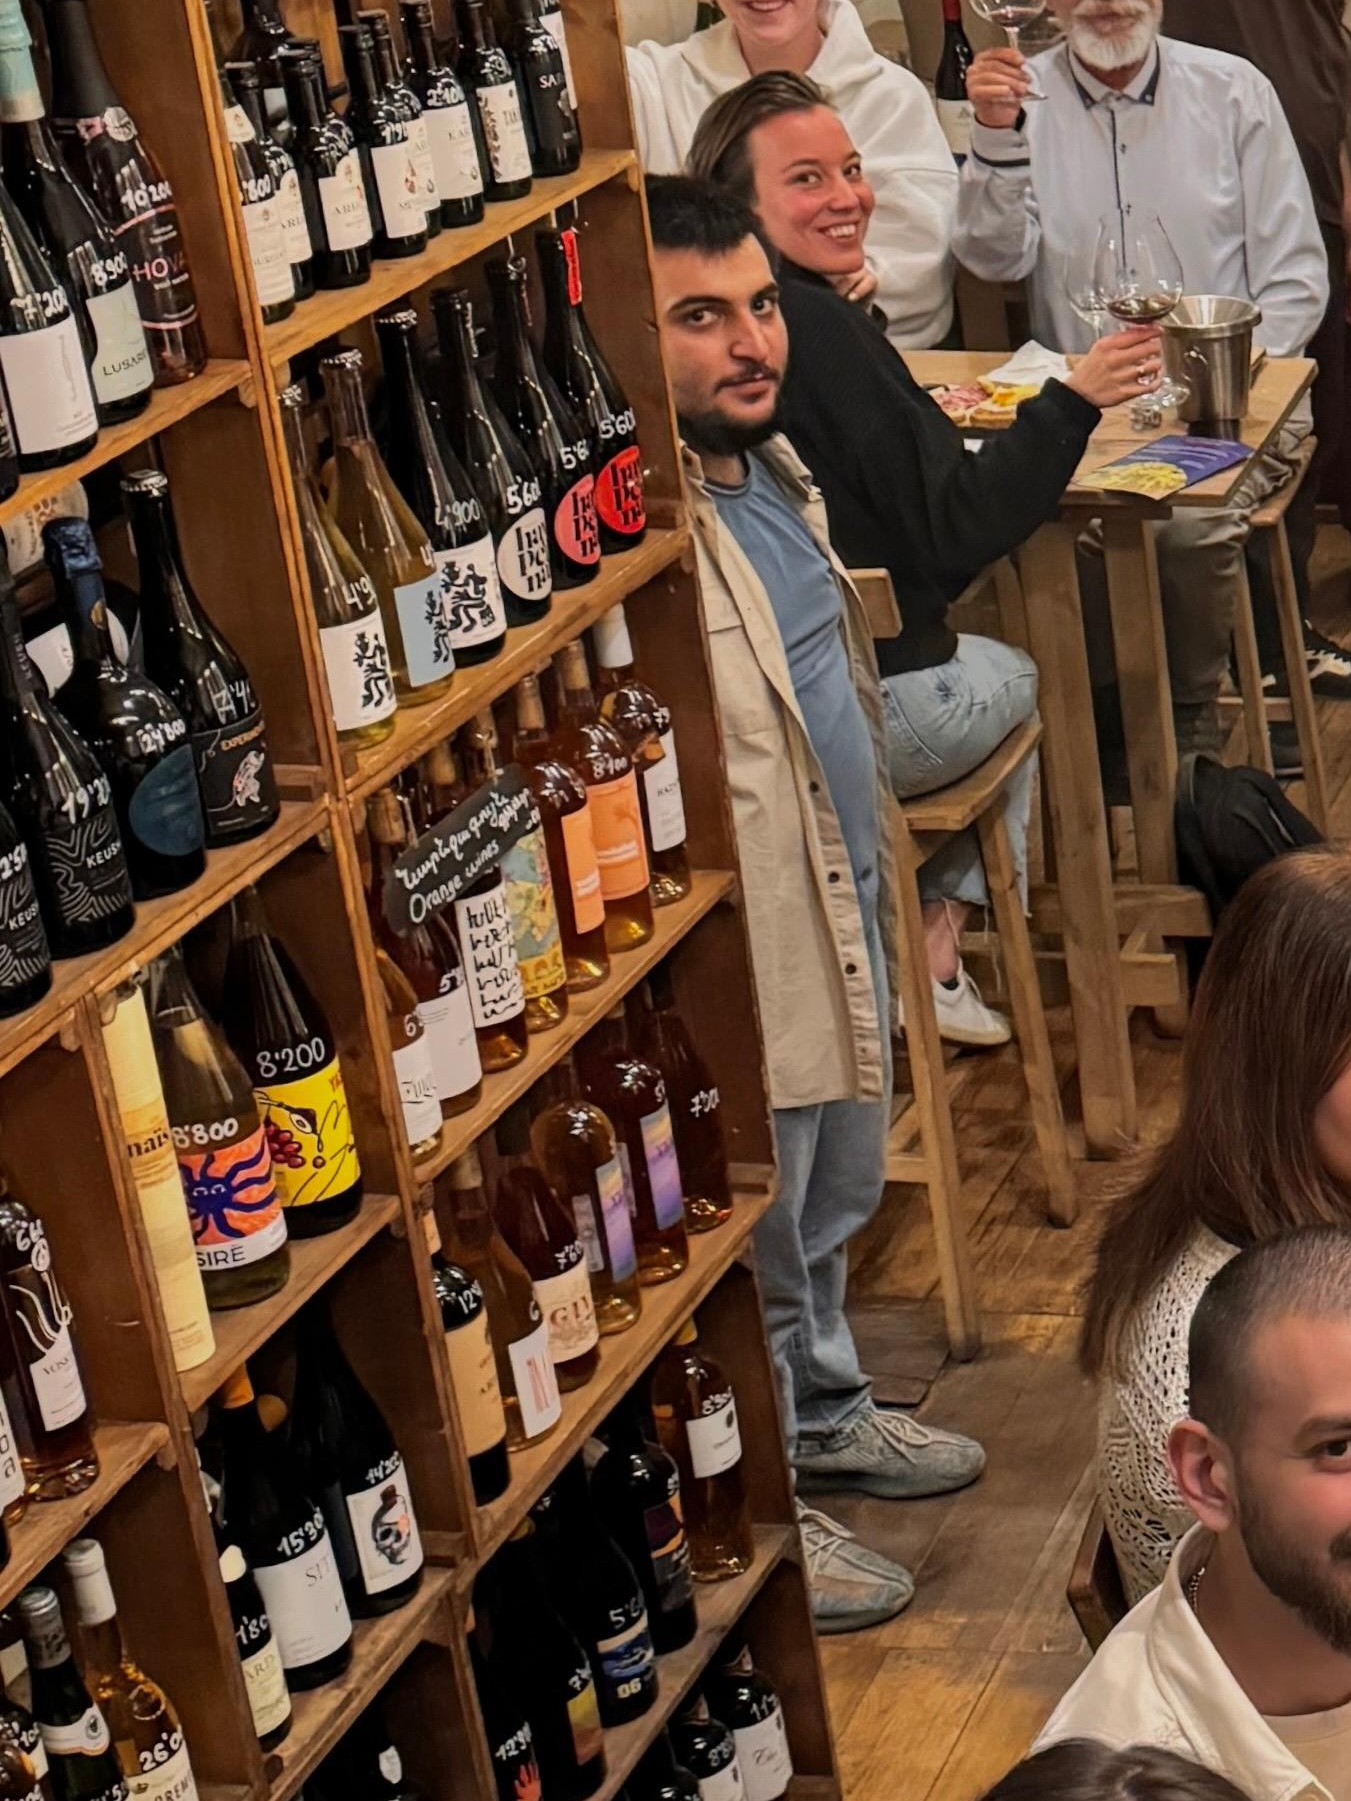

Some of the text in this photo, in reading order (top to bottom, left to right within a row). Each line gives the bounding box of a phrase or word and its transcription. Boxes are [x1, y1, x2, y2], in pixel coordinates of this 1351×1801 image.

[409, 839, 500, 923] Orange wines
[256, 1037, 325, 1079] 8'200
[171, 1117, 239, 1148] 8'800
